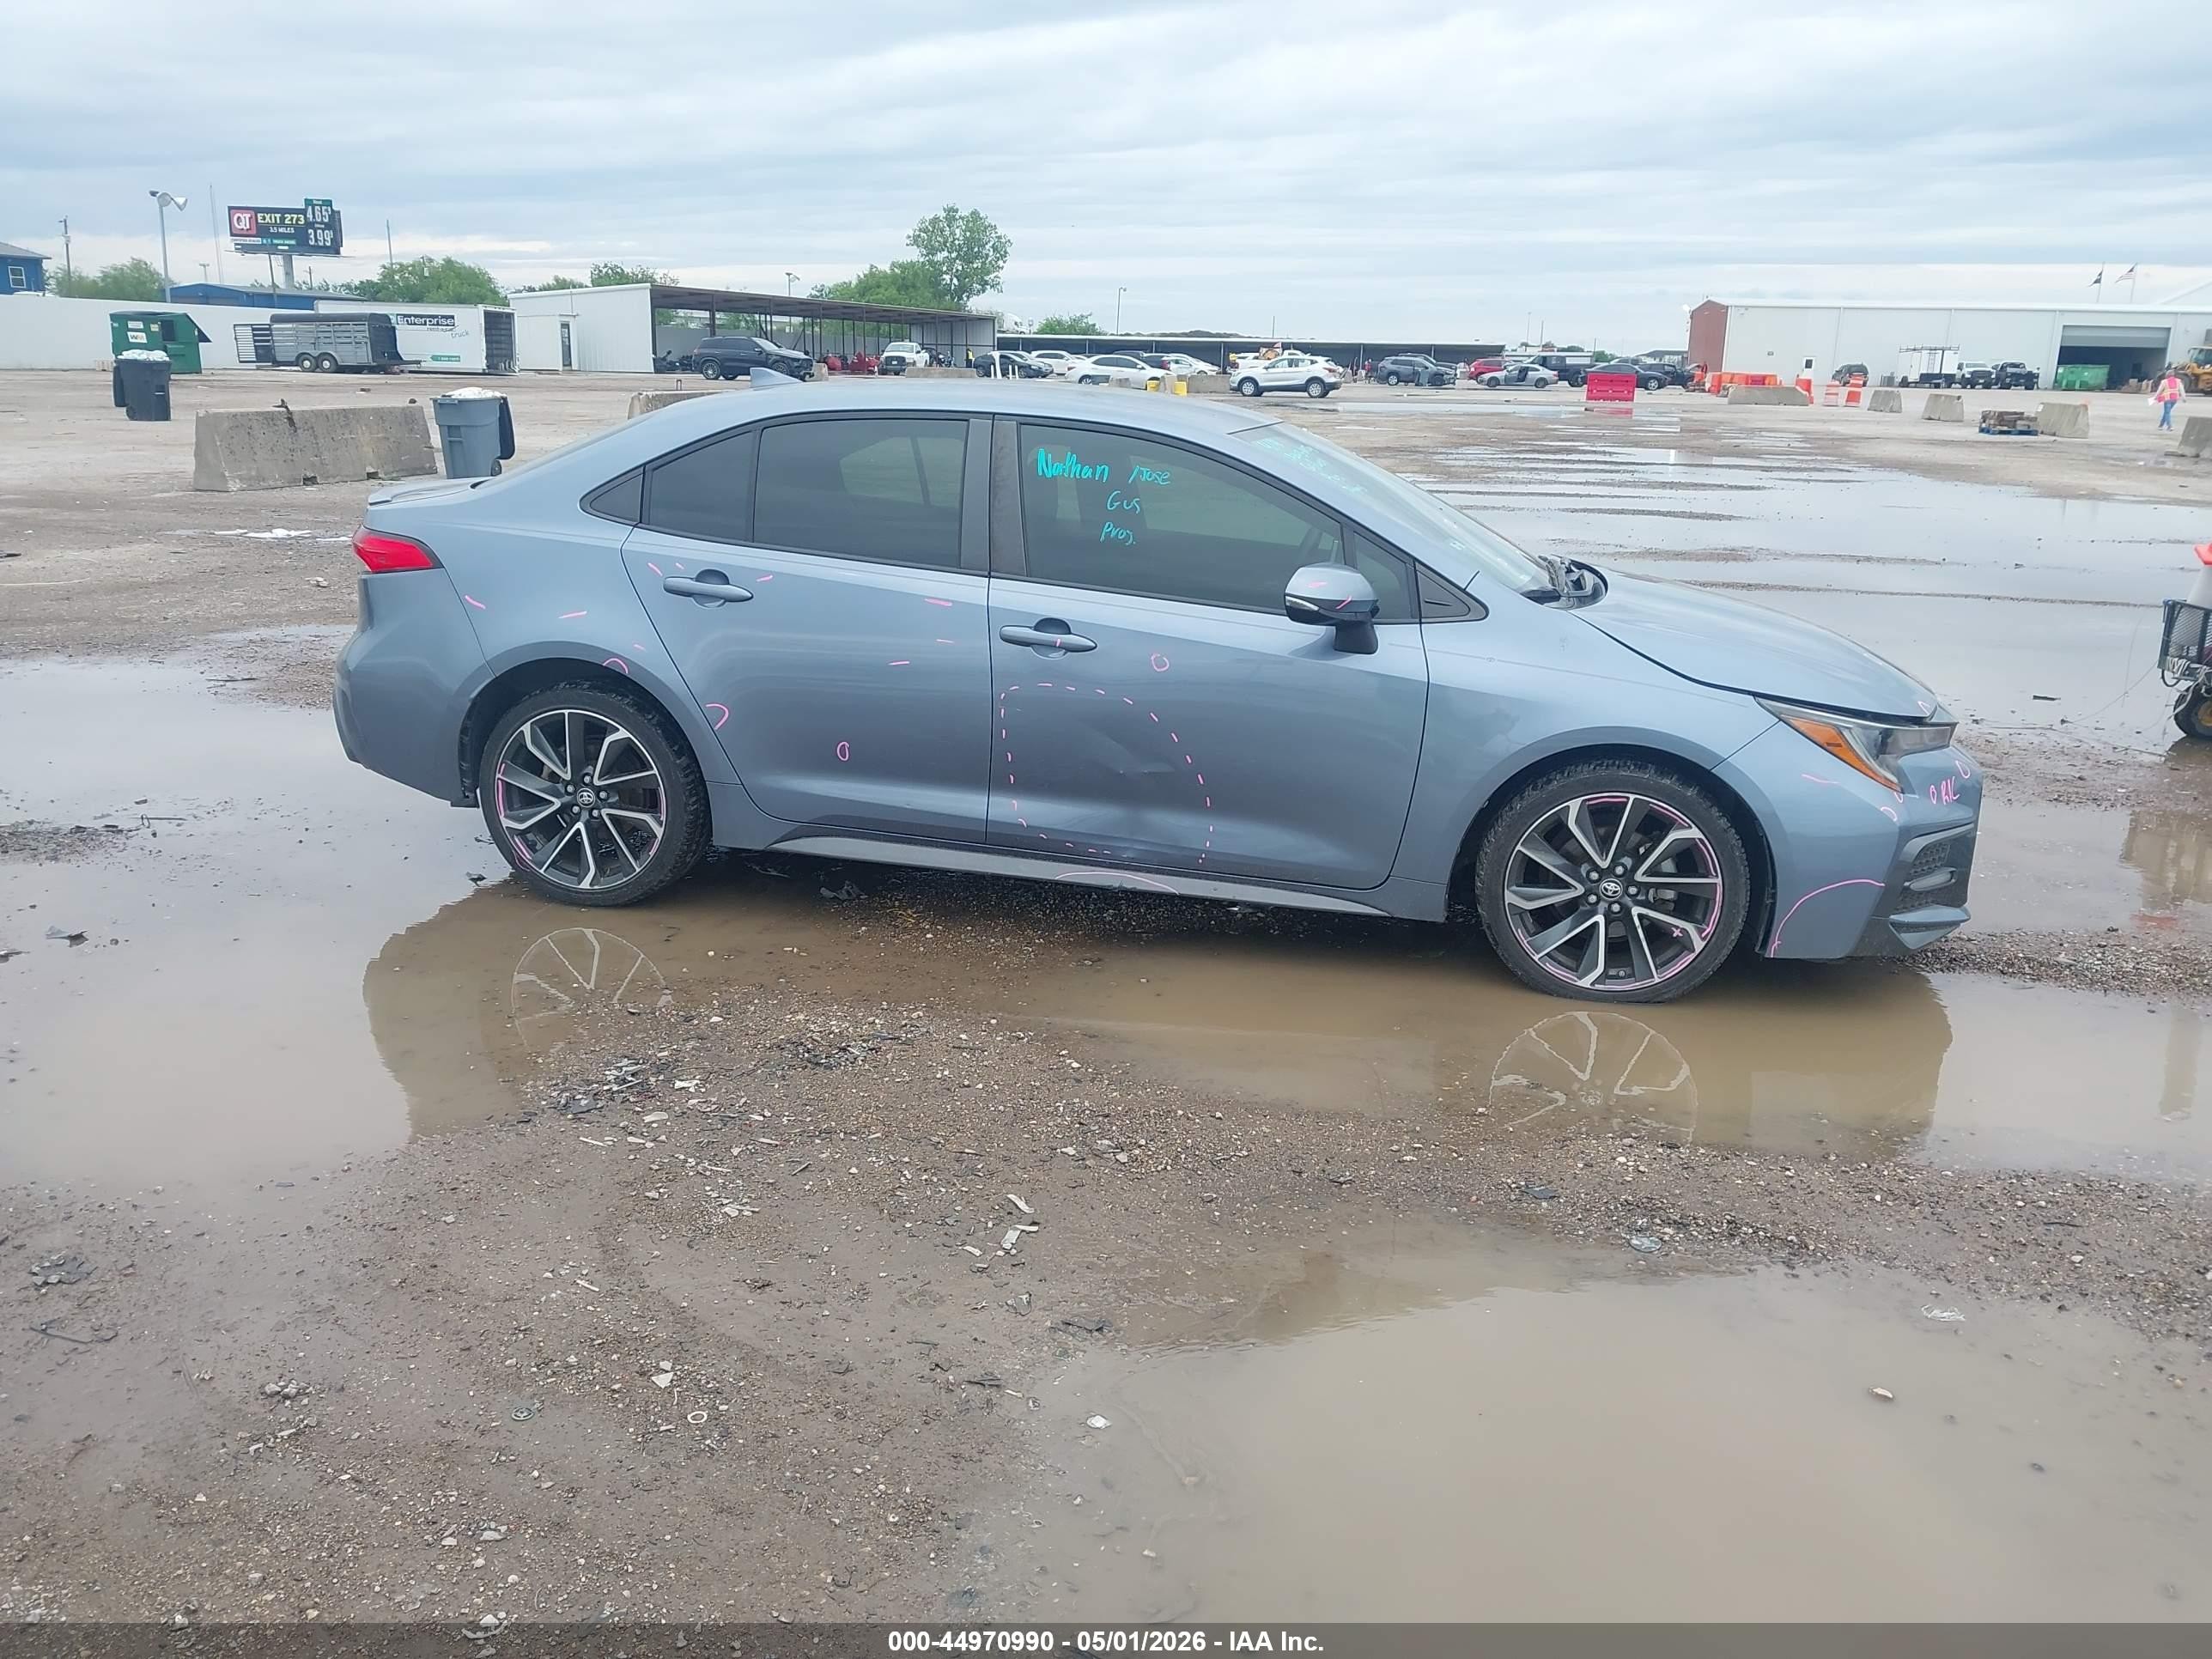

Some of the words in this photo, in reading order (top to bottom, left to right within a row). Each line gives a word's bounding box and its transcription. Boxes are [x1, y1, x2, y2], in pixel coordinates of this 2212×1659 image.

[233, 213, 252, 229] QT
[258, 213, 281, 224] EXIT
[284, 214, 305, 224] 273
[398, 316, 454, 325] Enterprise
[451, 329, 470, 338] truck
[1037, 448, 1109, 483] Nathan
[1107, 490, 1140, 514] Gus
